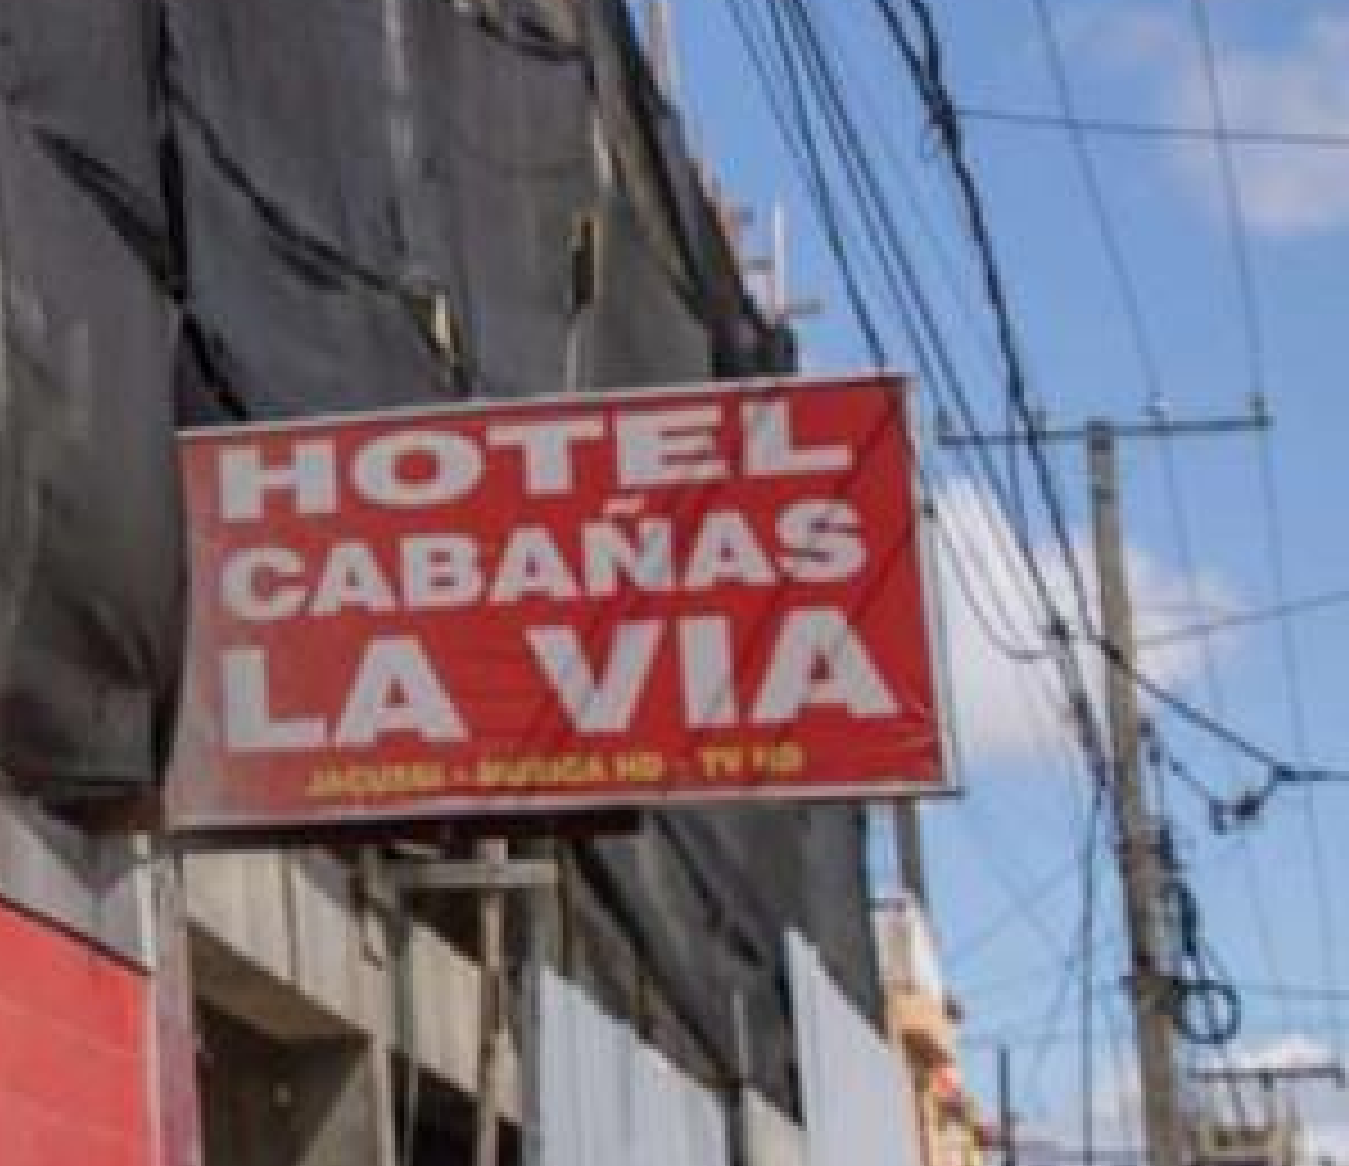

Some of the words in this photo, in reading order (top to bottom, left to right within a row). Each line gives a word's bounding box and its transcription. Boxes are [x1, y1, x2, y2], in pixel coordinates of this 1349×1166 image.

[218, 401, 852, 521] HOTEL
[220, 496, 868, 622] CABAÑAS
[220, 635, 468, 752] LA
[525, 608, 901, 734] VIA
